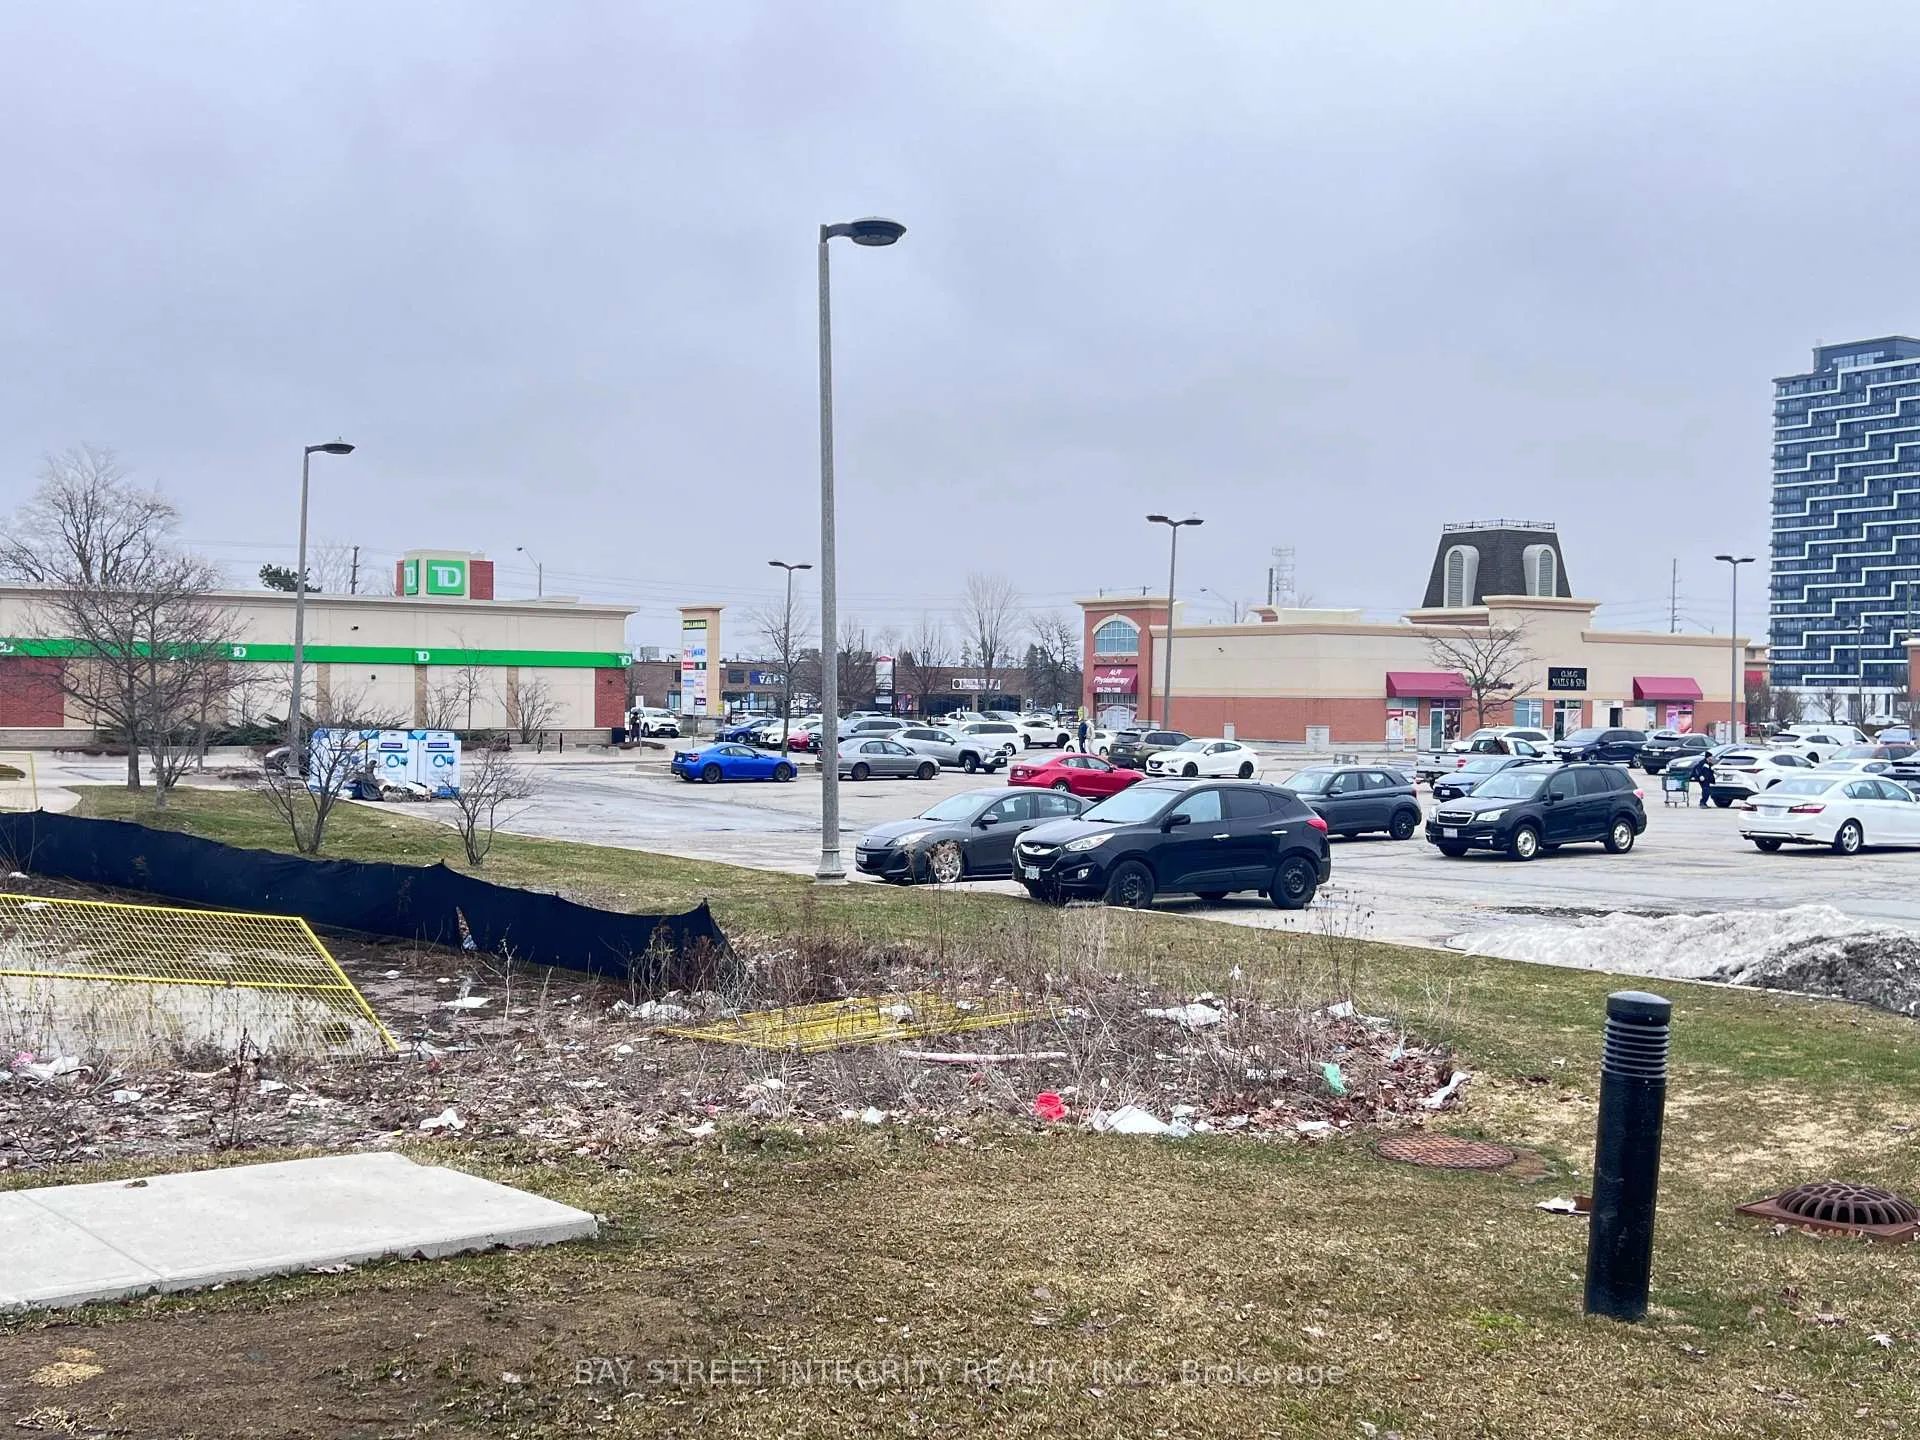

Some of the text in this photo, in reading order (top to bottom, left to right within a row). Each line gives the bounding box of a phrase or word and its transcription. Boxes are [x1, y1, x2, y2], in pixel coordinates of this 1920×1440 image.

[432, 566, 461, 587] TD
[416, 651, 430, 662] TD
[619, 655, 632, 666] TD
[1552, 678, 1586, 687] NAILS & SPA
